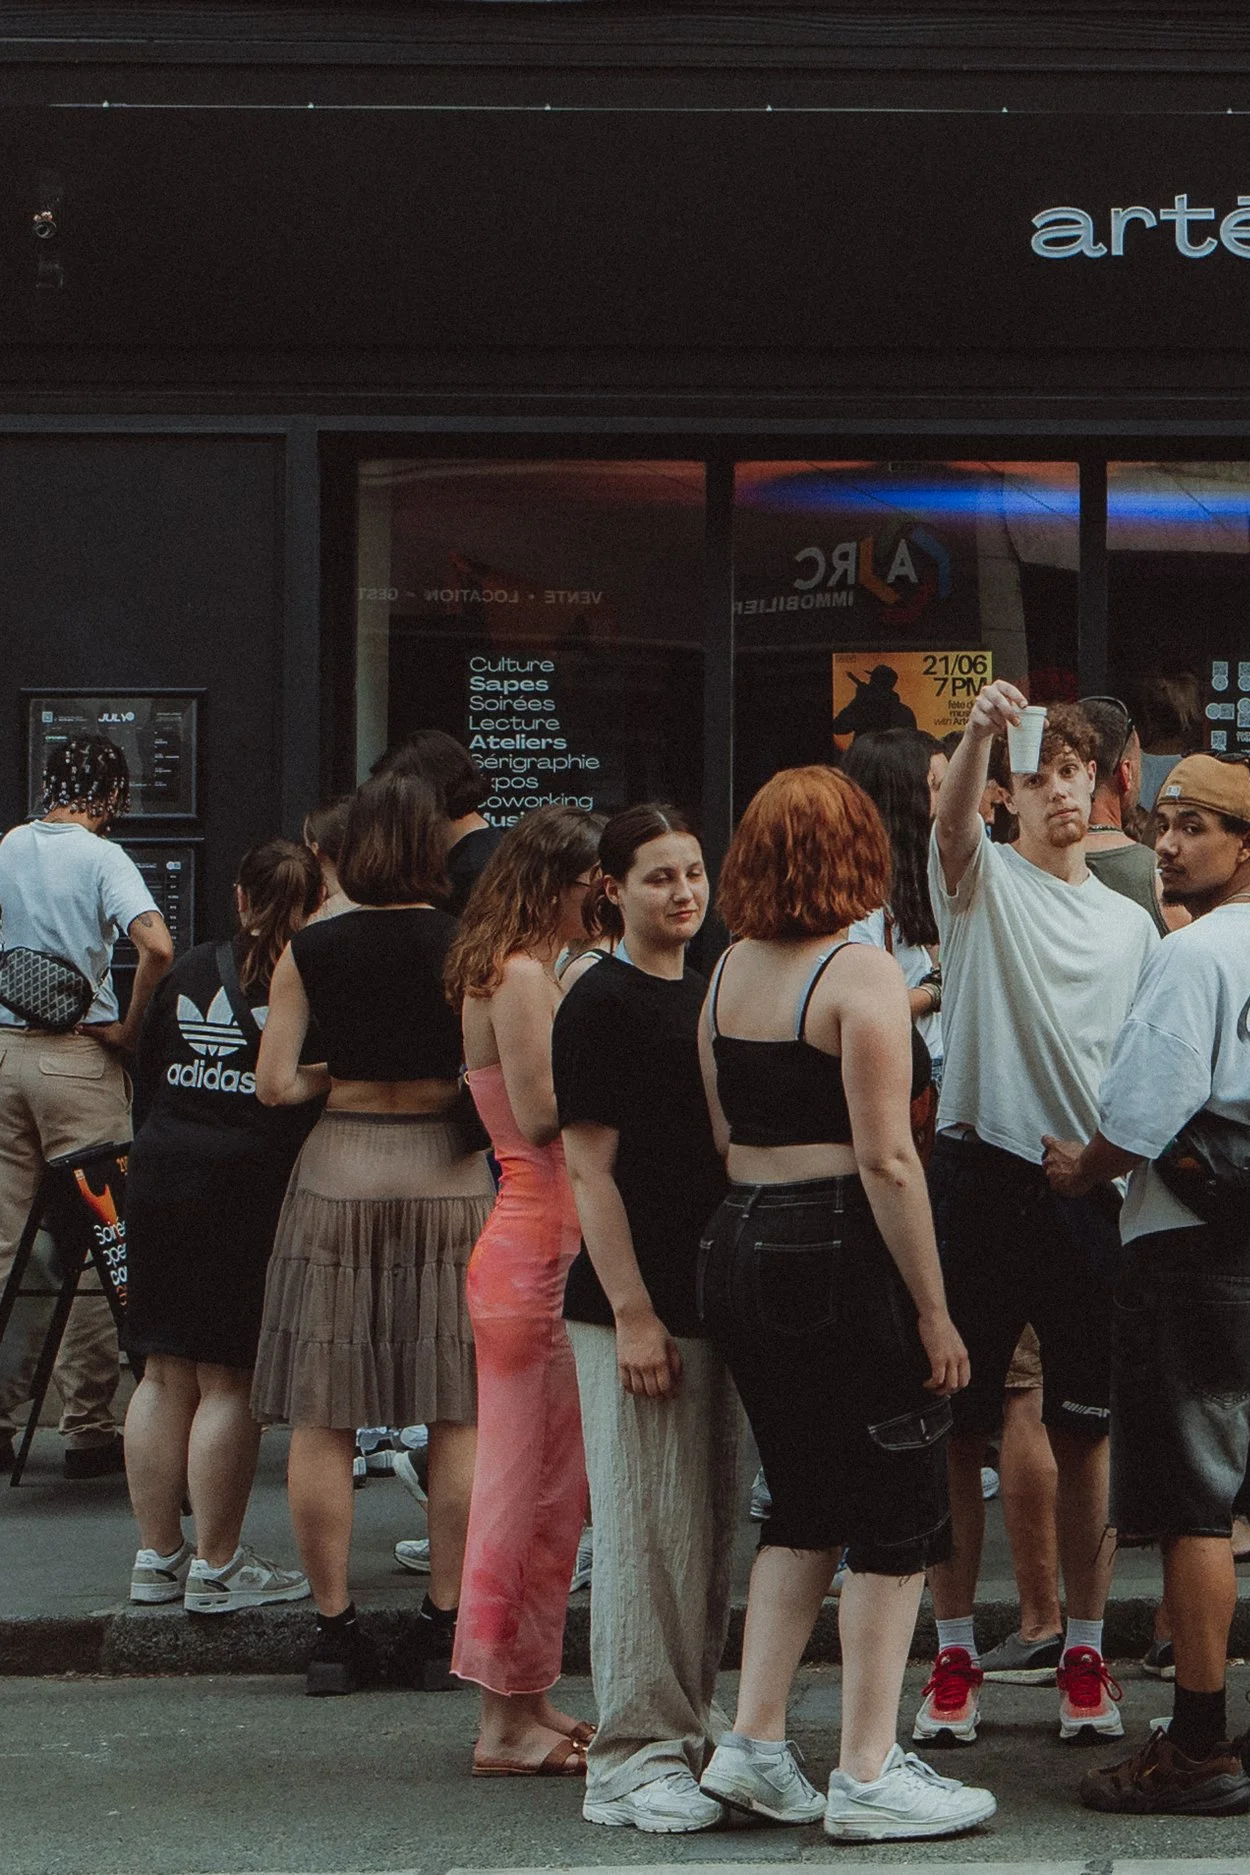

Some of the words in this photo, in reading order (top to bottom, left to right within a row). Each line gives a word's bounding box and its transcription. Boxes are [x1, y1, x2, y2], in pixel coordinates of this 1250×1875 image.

[469, 656, 555, 673] Culture
[922, 654, 988, 676] 21/06
[469, 676, 549, 695] Sapes
[933, 677, 949, 697] 7
[951, 677, 987, 698] PM
[469, 695, 556, 711] Soirées
[469, 715, 561, 731] Lecture
[952, 717, 969, 726] Art
[468, 734, 568, 750] Ateliers
[491, 776, 540, 793] pos
[478, 793, 594, 812] oworking
[167, 1059, 257, 1094] adidas
[93, 1216, 126, 1246] Soiré
